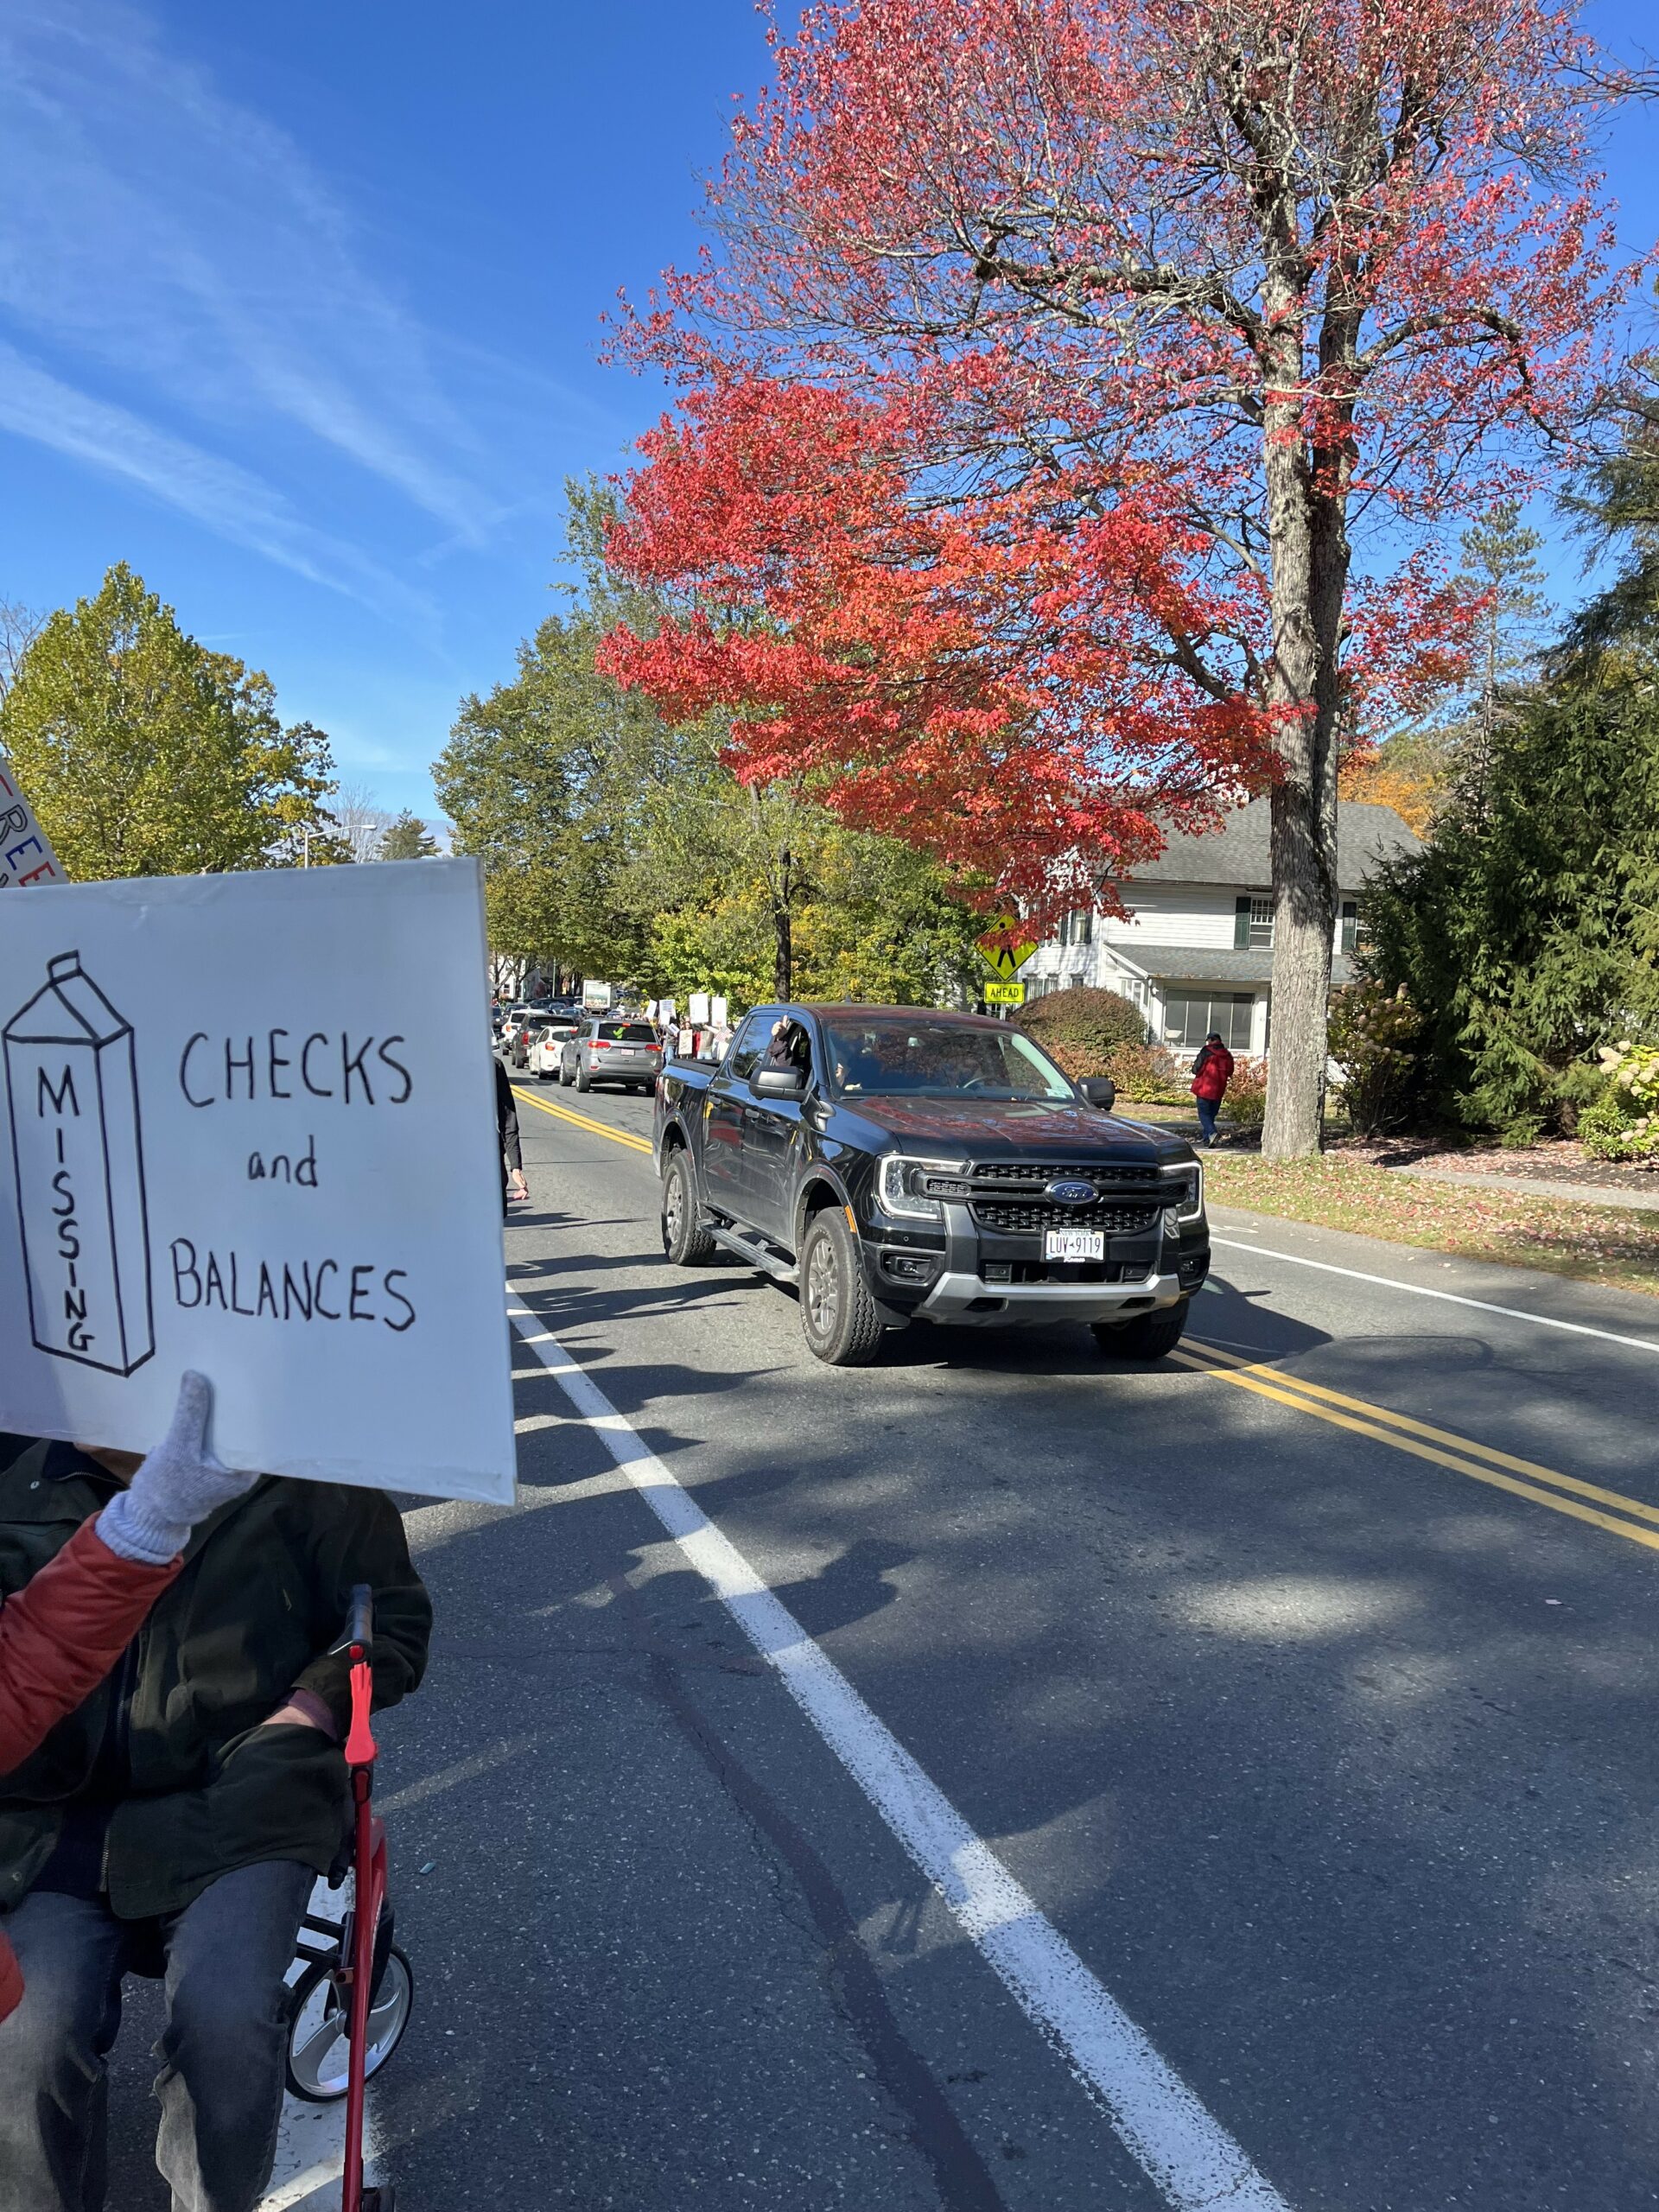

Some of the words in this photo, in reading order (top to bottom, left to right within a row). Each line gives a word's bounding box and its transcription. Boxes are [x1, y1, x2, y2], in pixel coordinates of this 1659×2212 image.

[0, 774, 55, 887] REE
[990, 988, 1019, 997] AHEAD
[179, 1028, 413, 1109] CHECKS
[247, 1134, 319, 1188] and
[37, 1064, 95, 1353] MISSING
[169, 1237, 416, 1332] BALANCES
